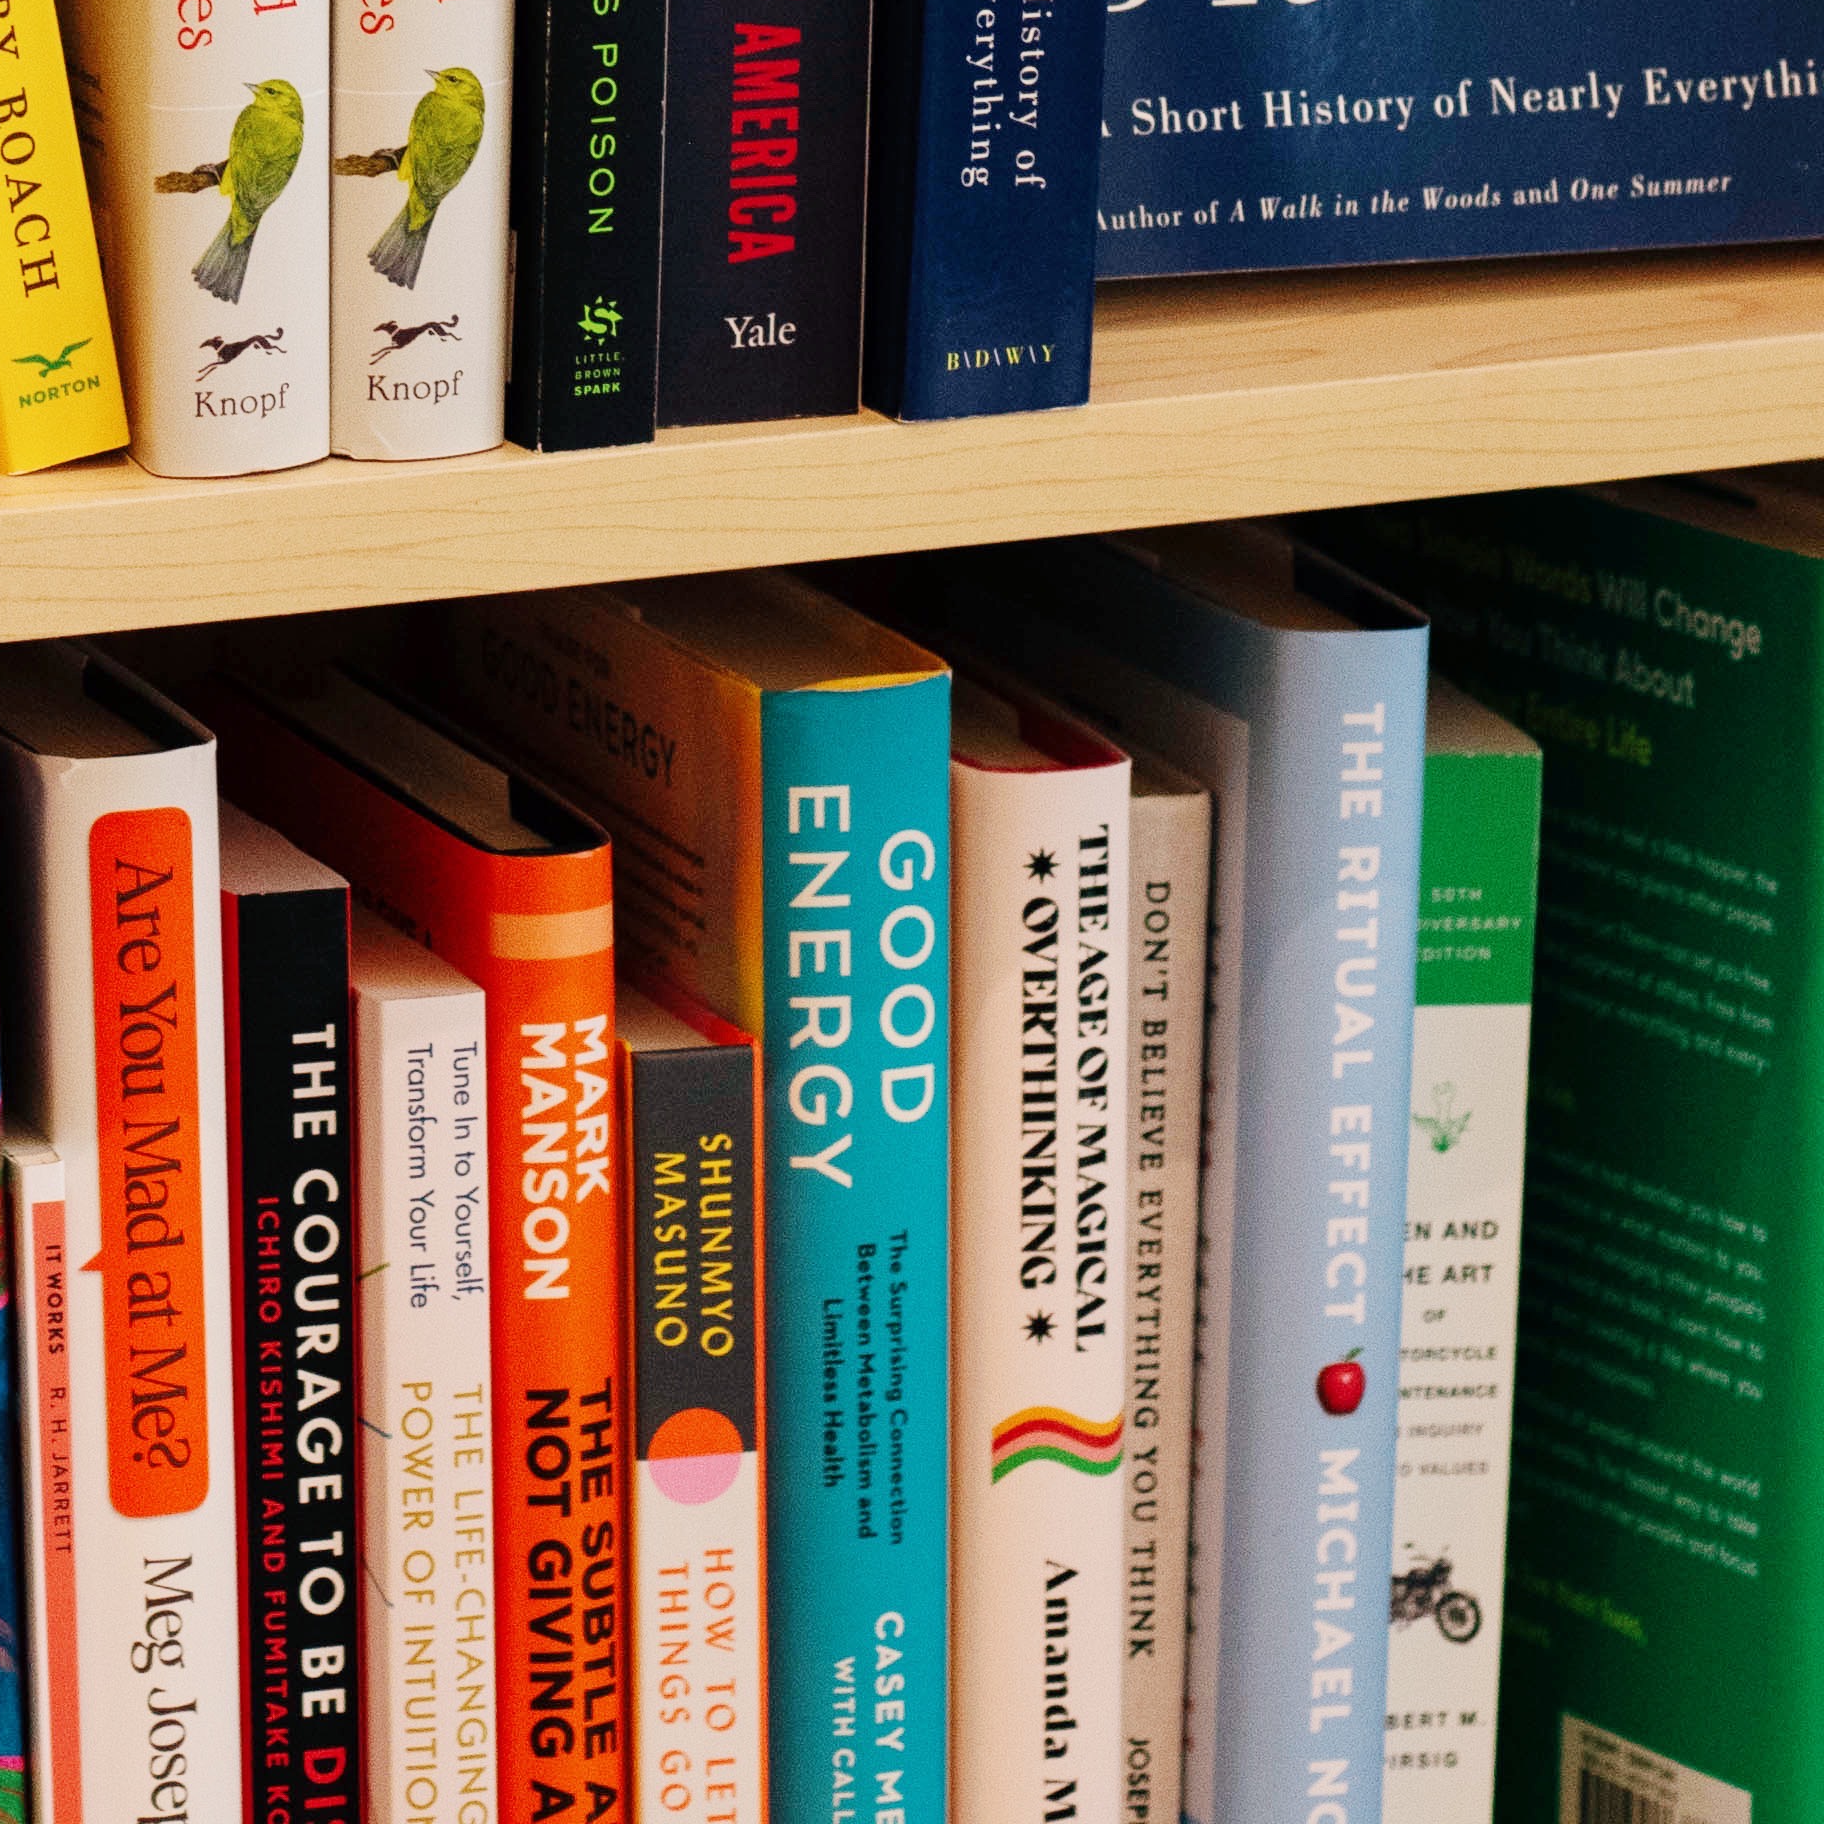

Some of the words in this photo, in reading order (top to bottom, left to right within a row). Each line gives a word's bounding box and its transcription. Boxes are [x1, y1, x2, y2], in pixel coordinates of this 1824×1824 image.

[588, 44, 621, 234] POISON
[727, 21, 802, 268] AMERICA
[19, 372, 101, 407] NORTON
[193, 384, 291, 419] Knopf
[726, 313, 797, 351] Yale
[1342, 704, 1385, 820] THE
[113, 857, 170, 972] Are
[1078, 824, 1109, 933] THE
[1142, 880, 1171, 1001] DON'T
[787, 783, 856, 1189] ENERGY
[877, 829, 937, 1125] GOOD
[1078, 941, 1109, 1037] AGE
[1335, 843, 1383, 1079] RITUAL
[118, 980, 177, 1098] You
[572, 1015, 610, 1203] MARK
[1021, 897, 1059, 1290] OVERTHINKING
[1076, 1047, 1108, 1113] OF
[1139, 1019, 1167, 1172] BELIEVE
[122, 1114, 187, 1258] Mad
[519, 1022, 572, 1302] MANSON
[1323, 1106, 1372, 1326] EFFECT
[132, 1270, 175, 1332] at
[653, 1151, 686, 1349] MASUNO
[698, 1132, 732, 1357] SHUNMYO
[1076, 1123, 1108, 1352] MAGICAL
[1132, 1188, 1164, 1430] EVERYTHING
[127, 1346, 192, 1472] Me?
[1130, 1439, 1160, 1525] YOU
[1128, 1541, 1158, 1659] THINK
